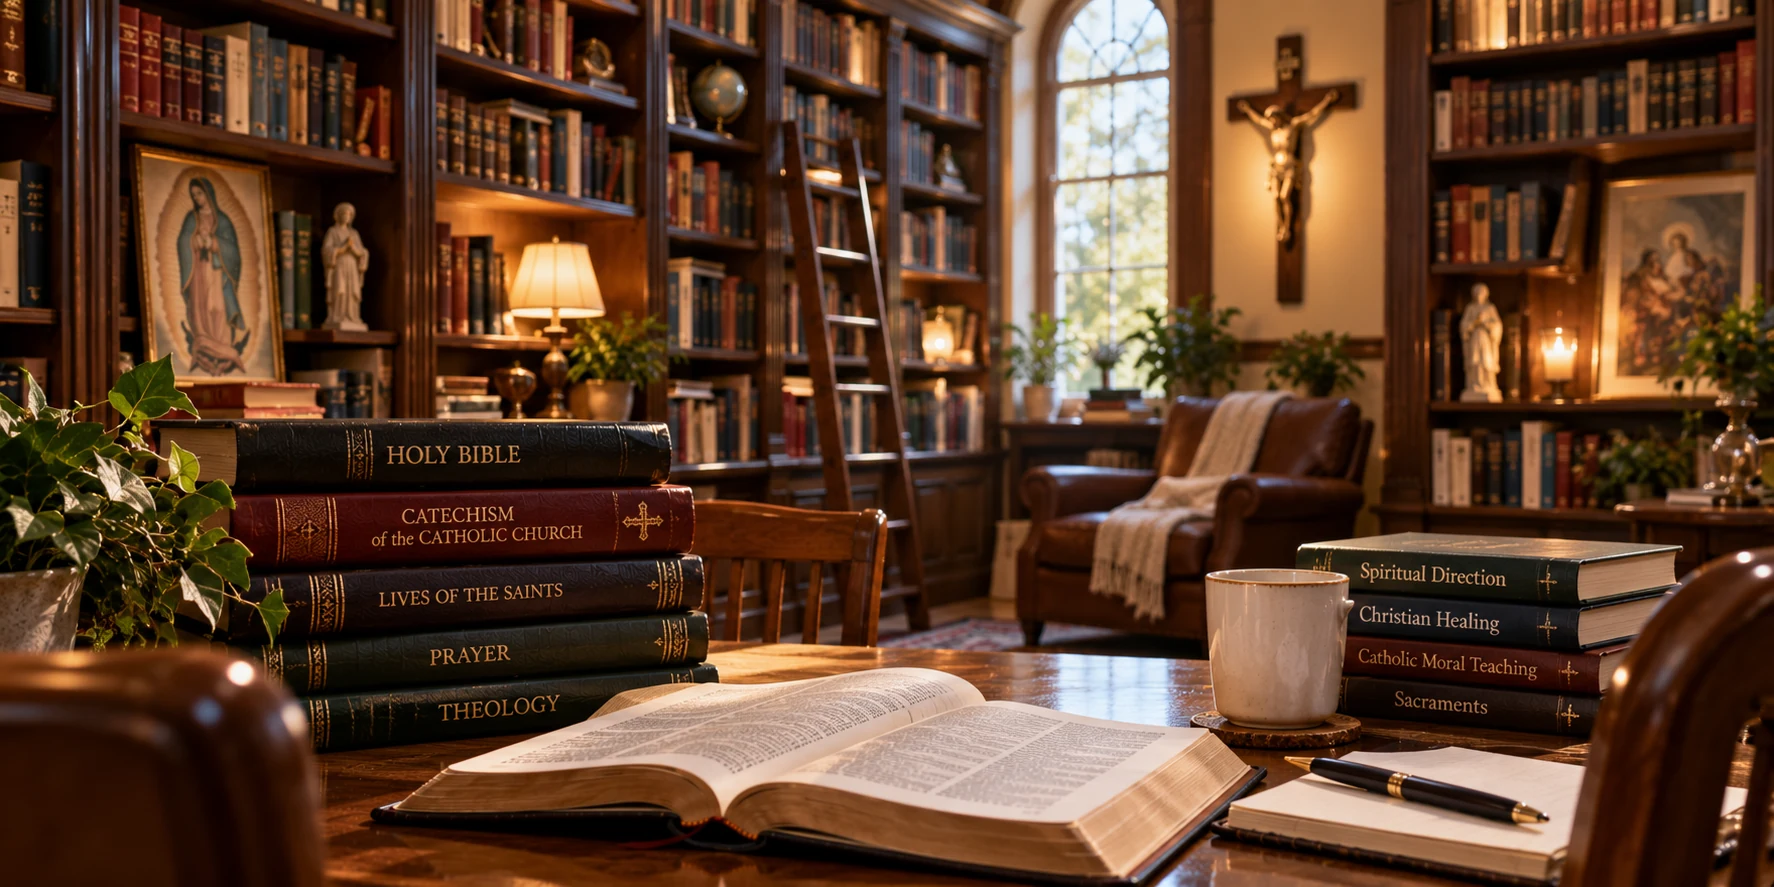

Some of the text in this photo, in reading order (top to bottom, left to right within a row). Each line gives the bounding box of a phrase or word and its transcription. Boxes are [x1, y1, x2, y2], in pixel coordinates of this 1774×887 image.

[387, 445, 521, 464] HOLY BIBLE
[402, 506, 514, 525] CATECHISM
[372, 525, 582, 546] of the CATHOLIC CHURCH
[1361, 562, 1506, 586] Spiritual Direction
[380, 583, 562, 607] LIVES OF THE SAINTS
[1360, 606, 1499, 635] Christian Healing
[431, 645, 510, 665] PRAYER
[1359, 648, 1537, 680] Catholic Moral Teaching
[439, 694, 560, 721] THEOLOGY
[1395, 691, 1487, 714] Sacraments
